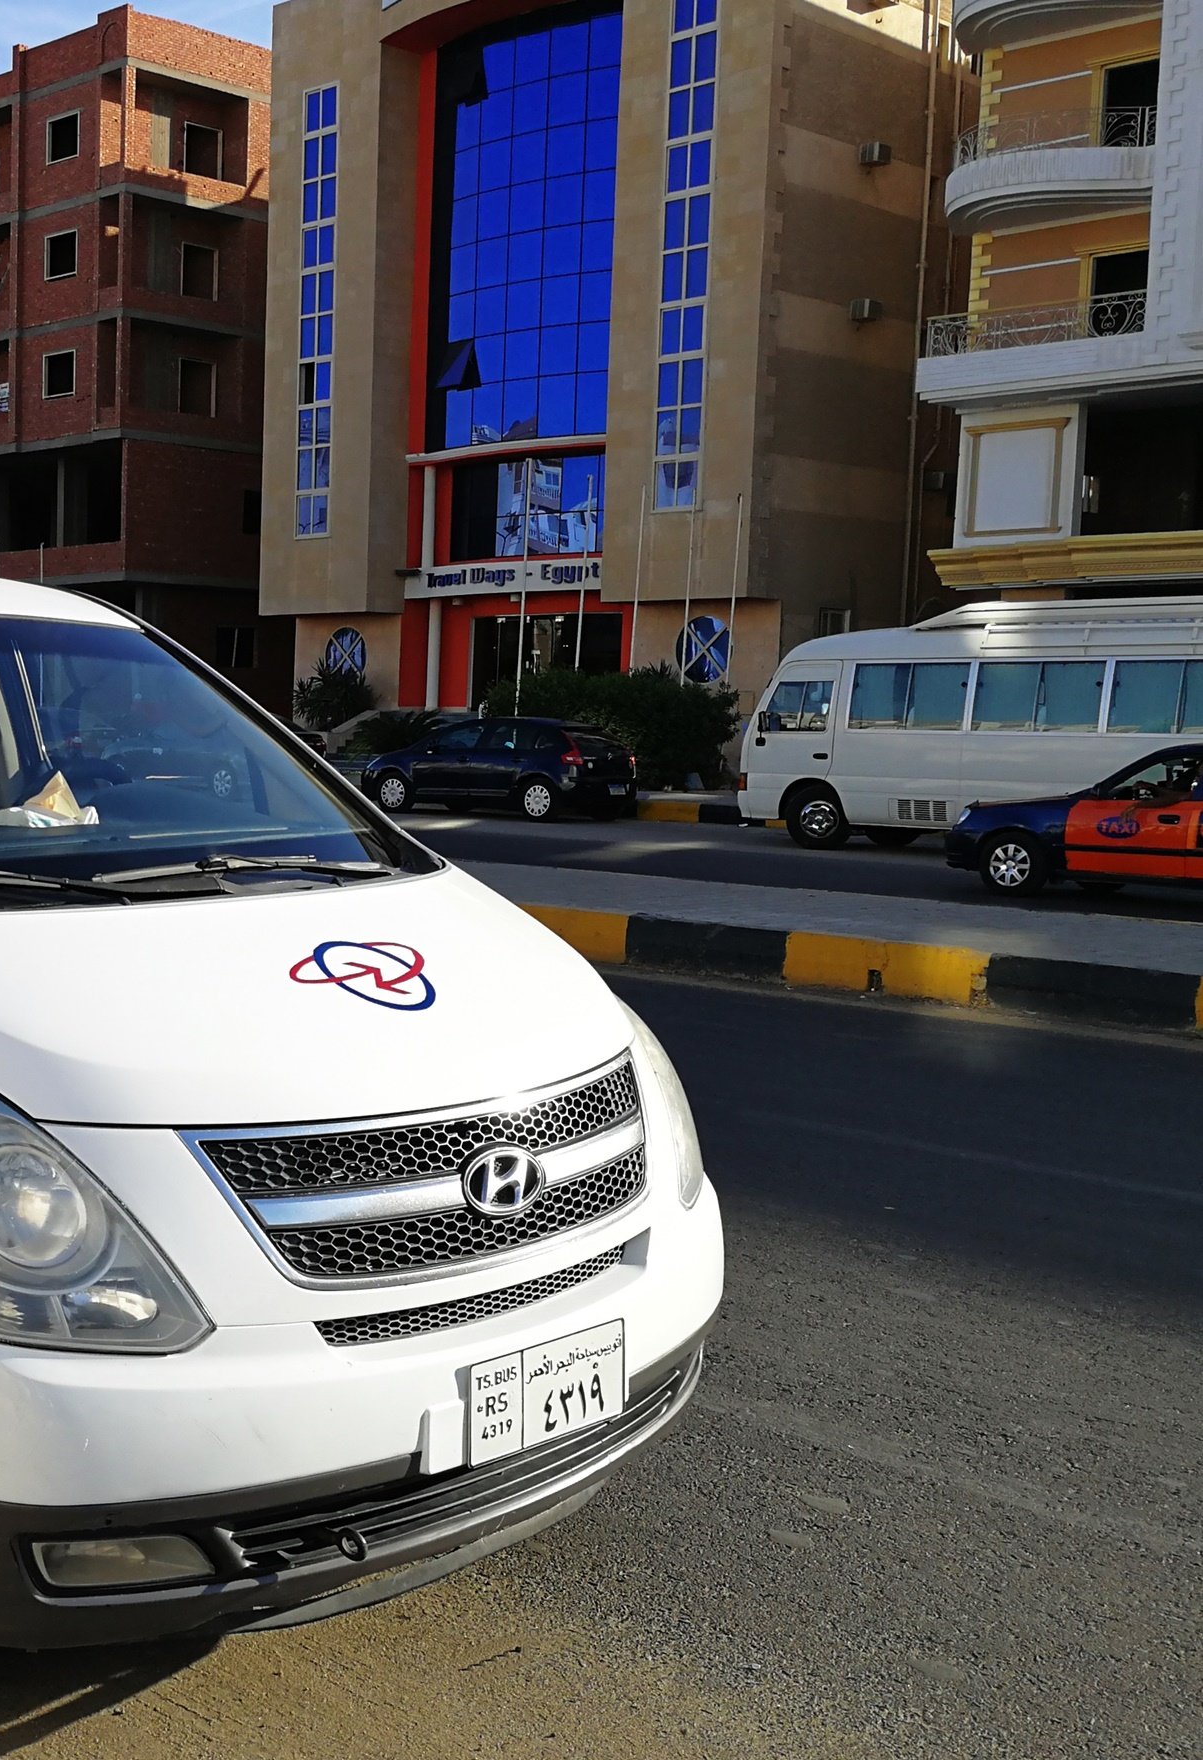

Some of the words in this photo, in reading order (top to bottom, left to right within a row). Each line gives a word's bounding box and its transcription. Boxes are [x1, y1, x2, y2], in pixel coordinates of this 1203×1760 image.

[426, 569, 466, 588] Travel
[470, 567, 516, 587] Ways
[541, 561, 600, 584] Egypt
[1100, 820, 1137, 834] TAXI
[475, 1366, 518, 1391] TS.BUS
[485, 1392, 509, 1418] RS
[543, 1372, 605, 1433] ٤٣١٩
[481, 1419, 513, 1440] 4319
